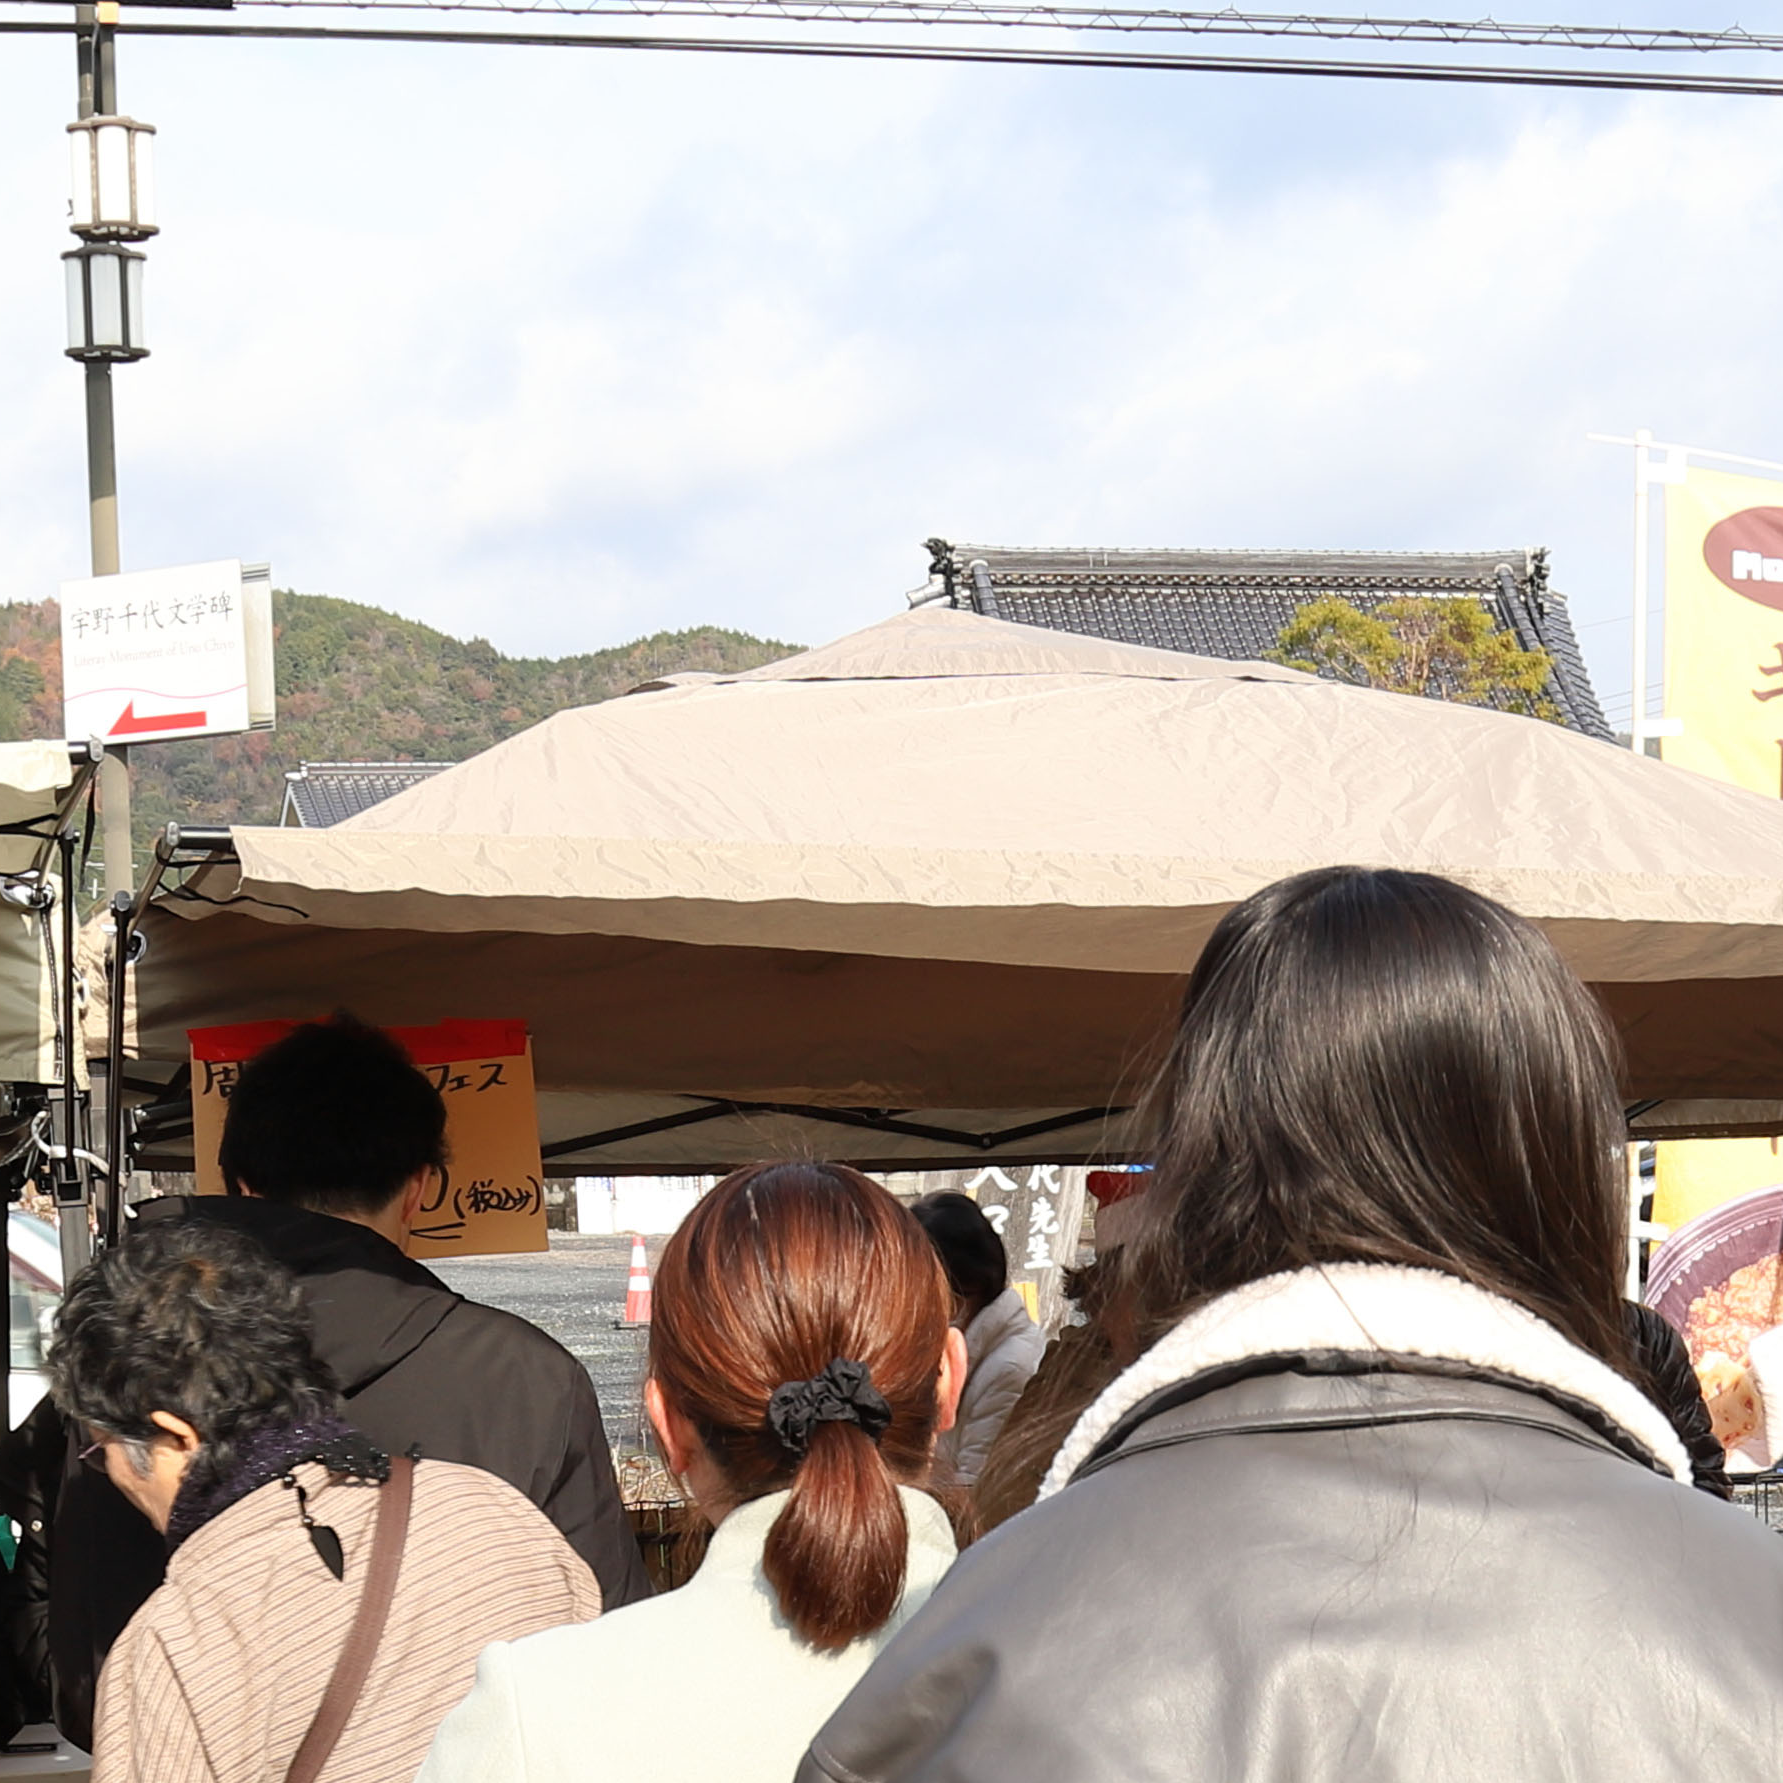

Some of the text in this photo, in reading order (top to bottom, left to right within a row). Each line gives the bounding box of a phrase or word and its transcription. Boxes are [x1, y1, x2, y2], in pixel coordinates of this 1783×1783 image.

[71, 590, 234, 639] 宇野千代文学碑
